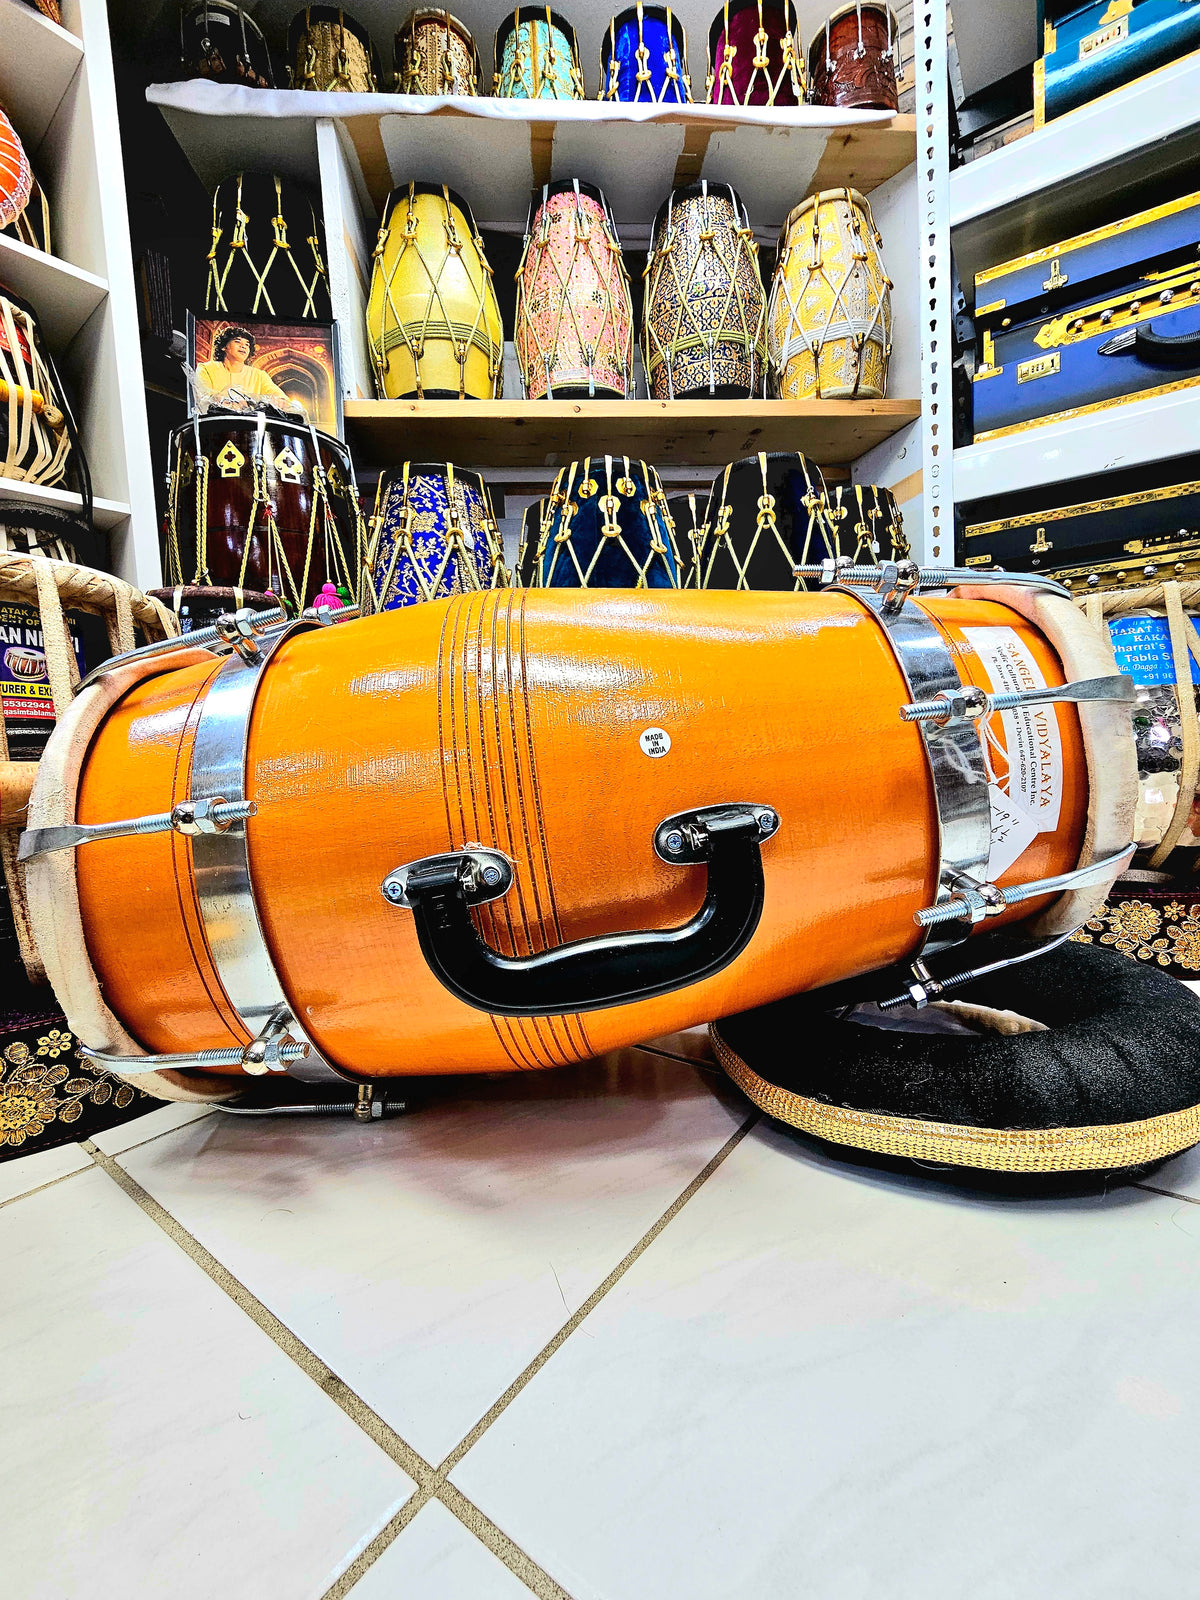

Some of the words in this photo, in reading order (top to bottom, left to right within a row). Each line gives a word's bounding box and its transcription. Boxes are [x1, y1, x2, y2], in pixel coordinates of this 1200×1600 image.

[26, 618, 39, 626] OF
[1110, 625, 1152, 636] HARAT
[1124, 653, 1159, 663] Tabla
[29, 685, 36, 695] &
[1004, 642, 1035, 691] SANGE
[1034, 711, 1052, 808] VIDYALAYA
[645, 733, 664, 742] MADE
[1016, 727, 1024, 748] Devin
[1023, 711, 1036, 759] Educational
[648, 746, 667, 755] INDIA
